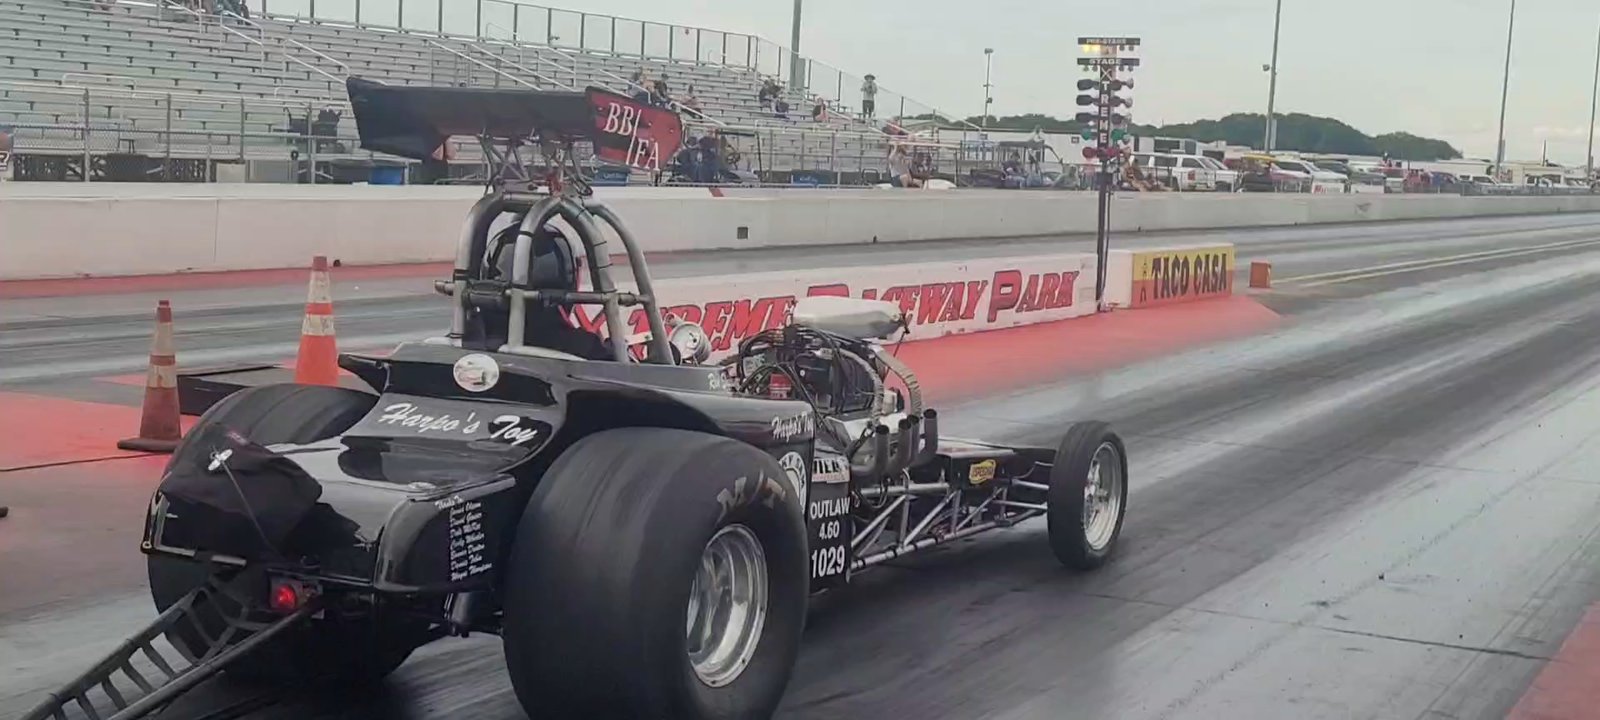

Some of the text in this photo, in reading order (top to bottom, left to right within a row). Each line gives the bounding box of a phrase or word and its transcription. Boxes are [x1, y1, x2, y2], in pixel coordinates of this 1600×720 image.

[1152, 252, 1228, 299] TACO CASA
[987, 269, 1080, 323] PARK
[378, 402, 538, 446] Harpo's Toy
[810, 497, 851, 519] OUTLAW
[819, 520, 840, 540] 4.60
[812, 545, 846, 578] 1029
